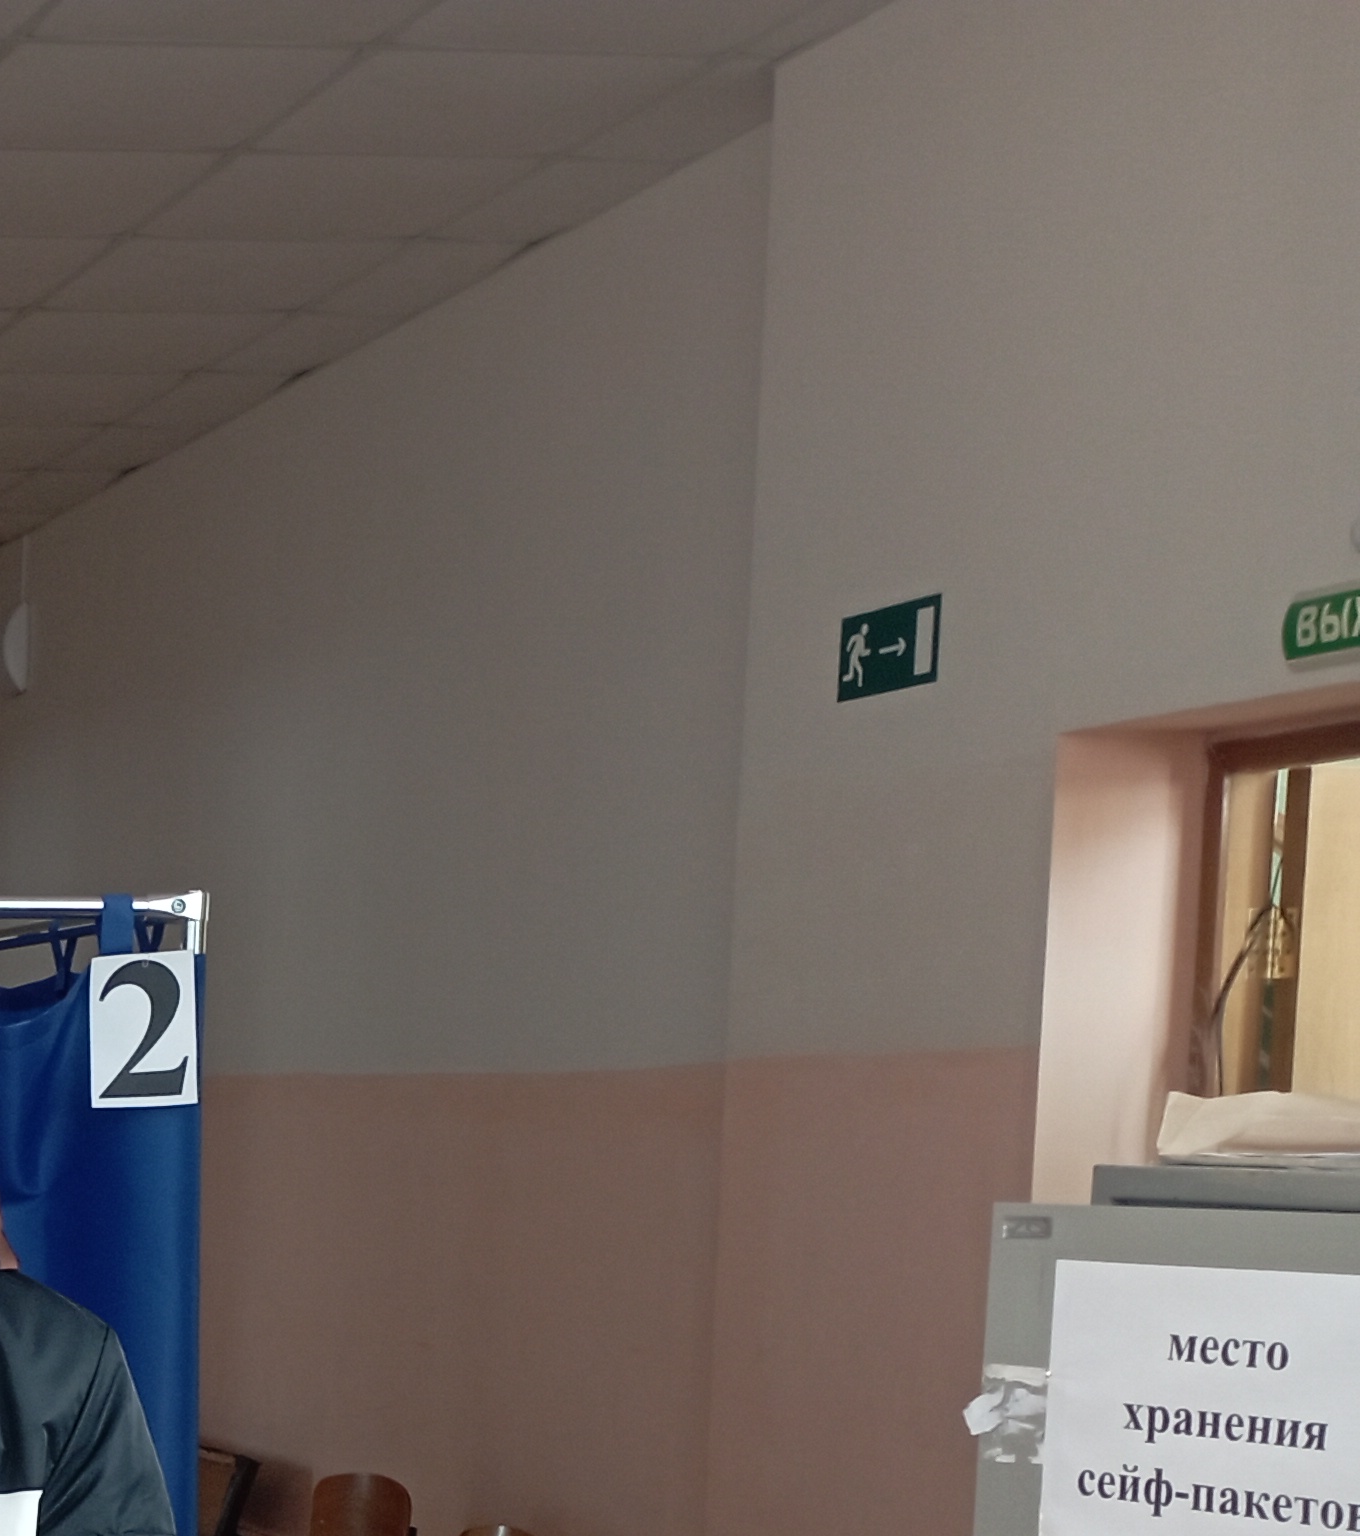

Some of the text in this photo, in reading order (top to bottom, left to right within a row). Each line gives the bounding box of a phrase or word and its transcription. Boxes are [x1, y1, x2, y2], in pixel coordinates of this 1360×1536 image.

[98, 958, 190, 1100] 2
[1167, 1333, 1290, 1371] место
[1122, 1402, 1329, 1452] хранения
